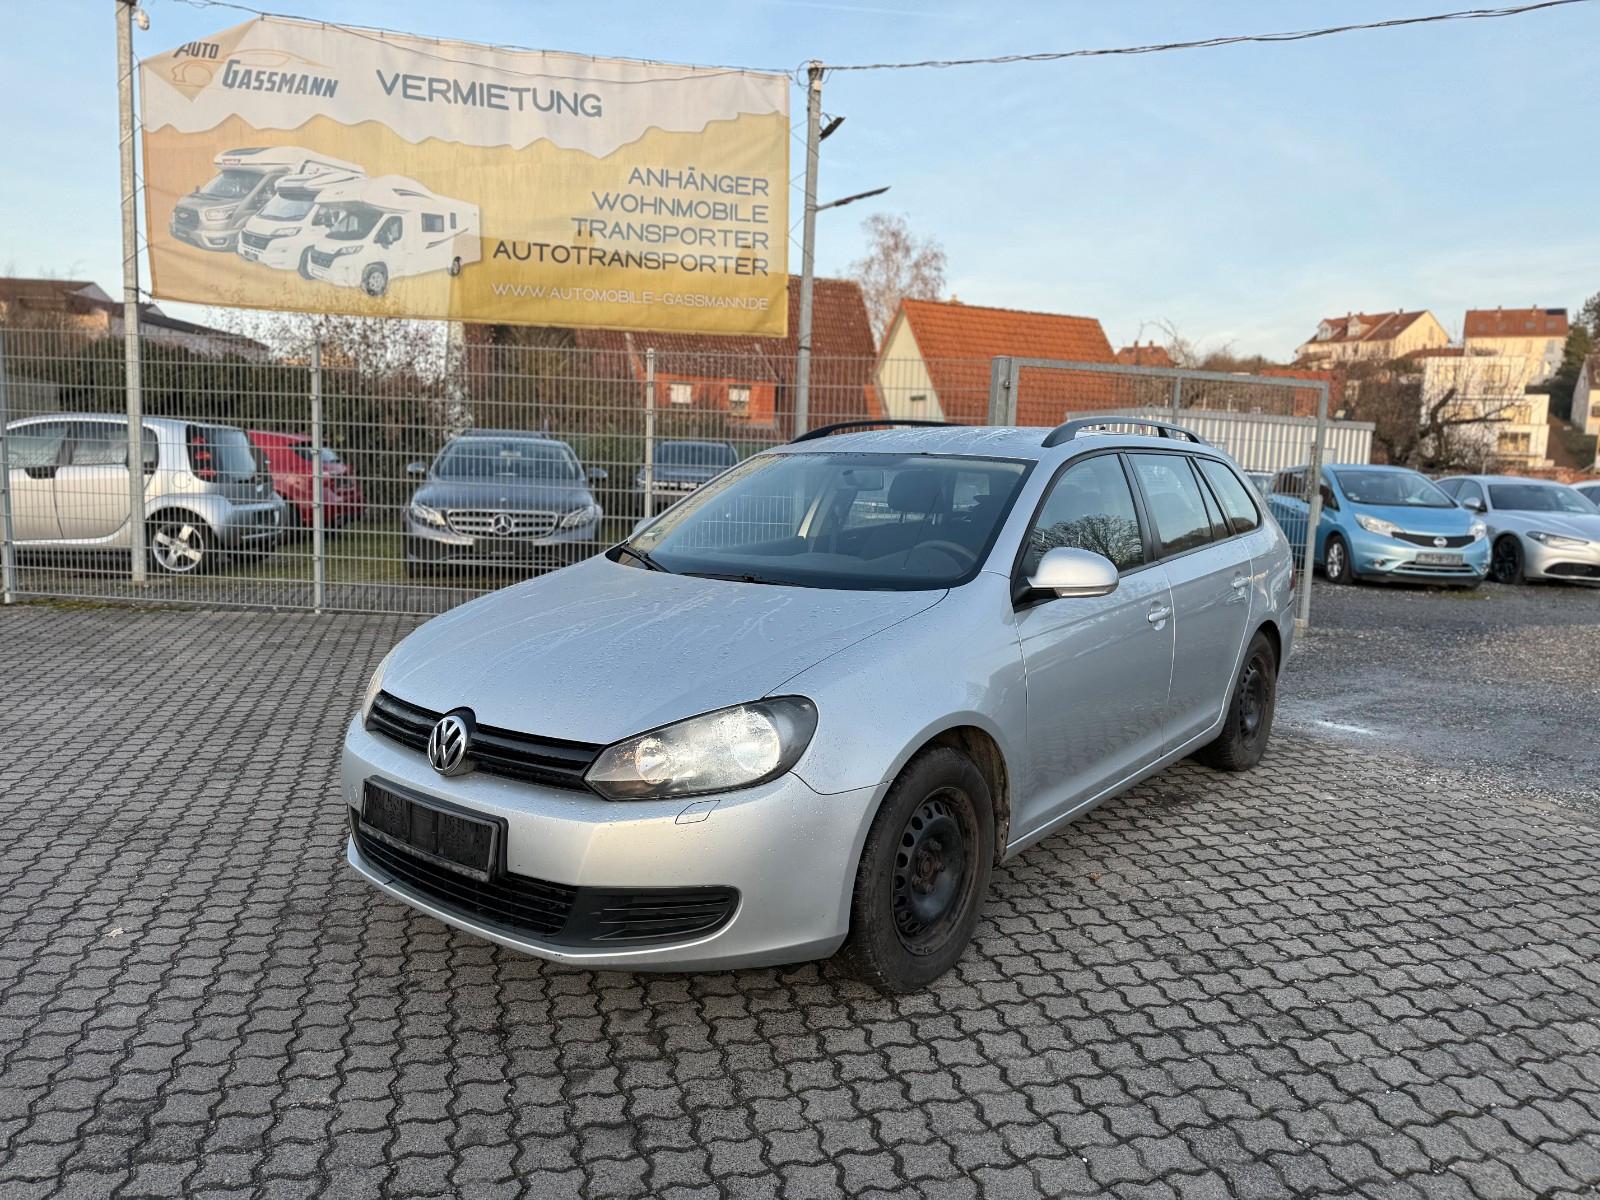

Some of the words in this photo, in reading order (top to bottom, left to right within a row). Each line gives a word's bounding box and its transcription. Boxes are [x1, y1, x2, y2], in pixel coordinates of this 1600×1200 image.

[173, 41, 220, 59] AUTO
[222, 59, 339, 98] GASSMANN
[376, 69, 602, 117] VERMIETUNG
[628, 167, 769, 196] ANHÄNGER
[592, 191, 769, 223] WOHNMOBILE
[571, 217, 769, 249] TRANSPORTER
[493, 240, 769, 276] AUTOTRANSPORTER
[491, 283, 769, 311] WWW.AUTOMOBILE-GASSMANN.DE
[428, 715, 467, 775] VW
